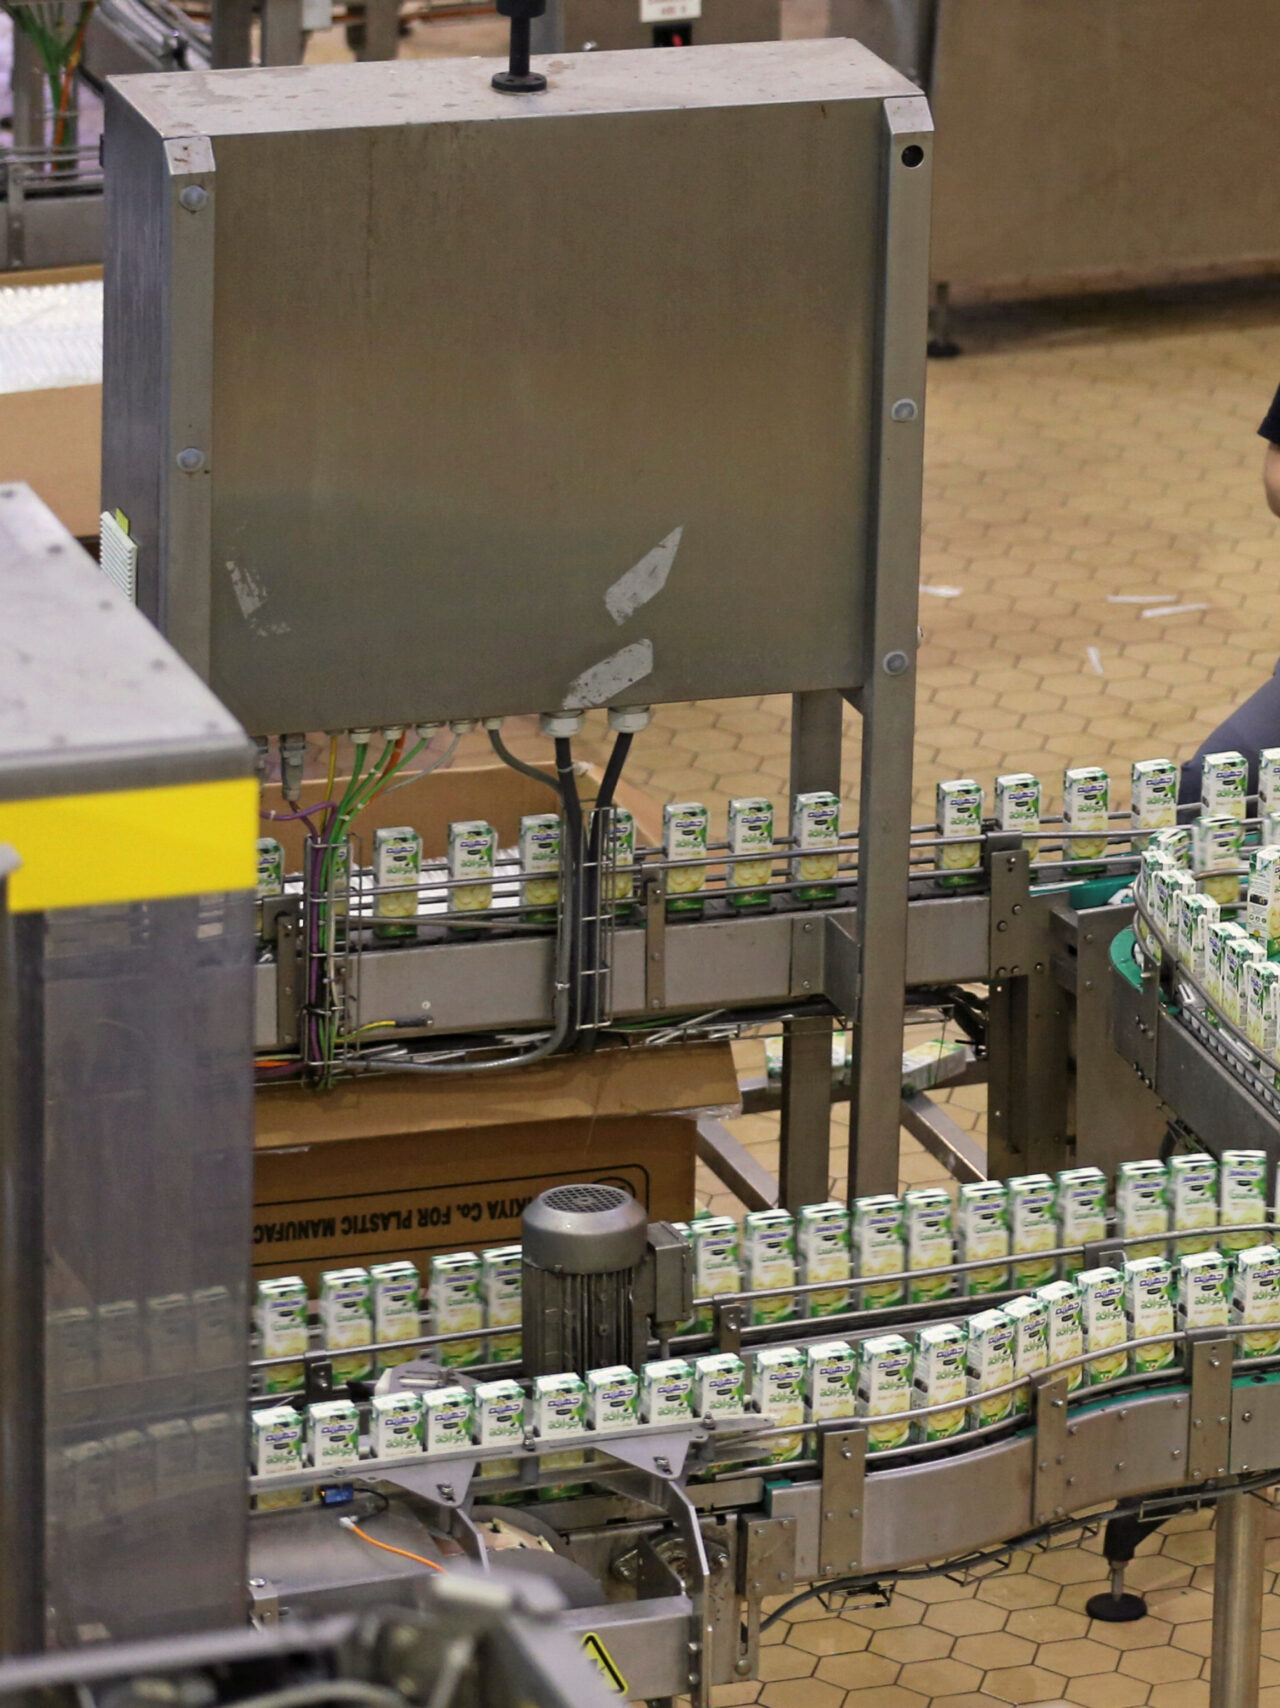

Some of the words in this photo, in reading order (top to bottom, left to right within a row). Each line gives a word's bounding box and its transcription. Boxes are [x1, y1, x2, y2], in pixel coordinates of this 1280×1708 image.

[341, 1209, 412, 1235] PLASTIC
[417, 1205, 451, 1228] FOR
[456, 1202, 483, 1222] Co.
